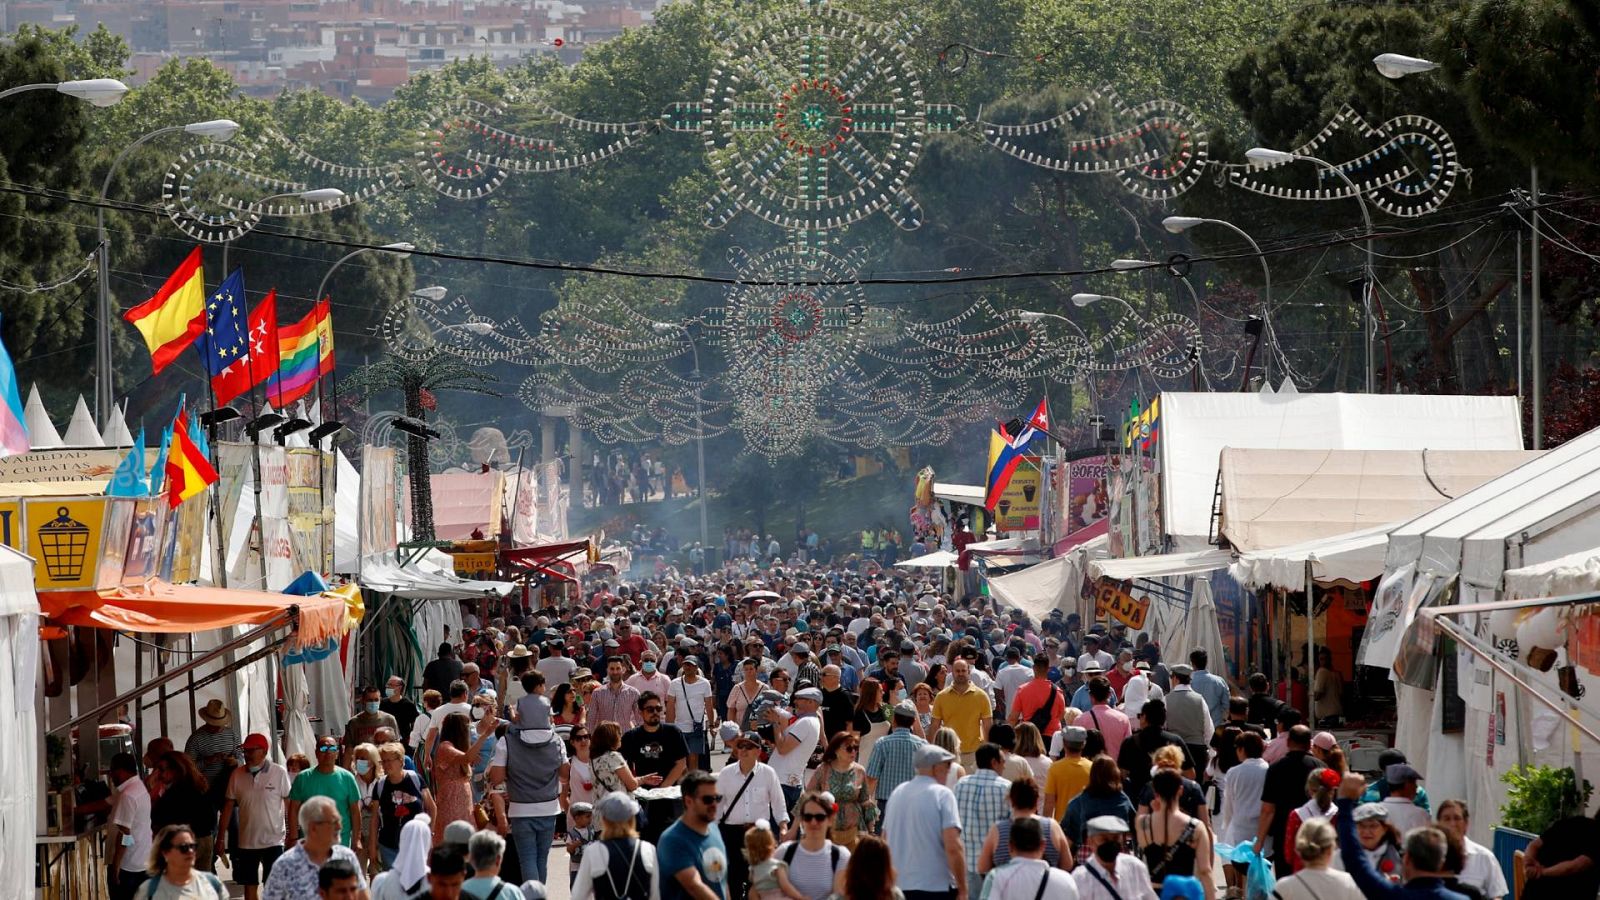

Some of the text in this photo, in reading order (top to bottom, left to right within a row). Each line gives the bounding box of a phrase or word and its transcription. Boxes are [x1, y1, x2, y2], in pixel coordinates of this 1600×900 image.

[1, 452, 88, 464] VARIEDAD
[13, 462, 91, 474] CUBATAS
[1102, 589, 1140, 623] CAJA
